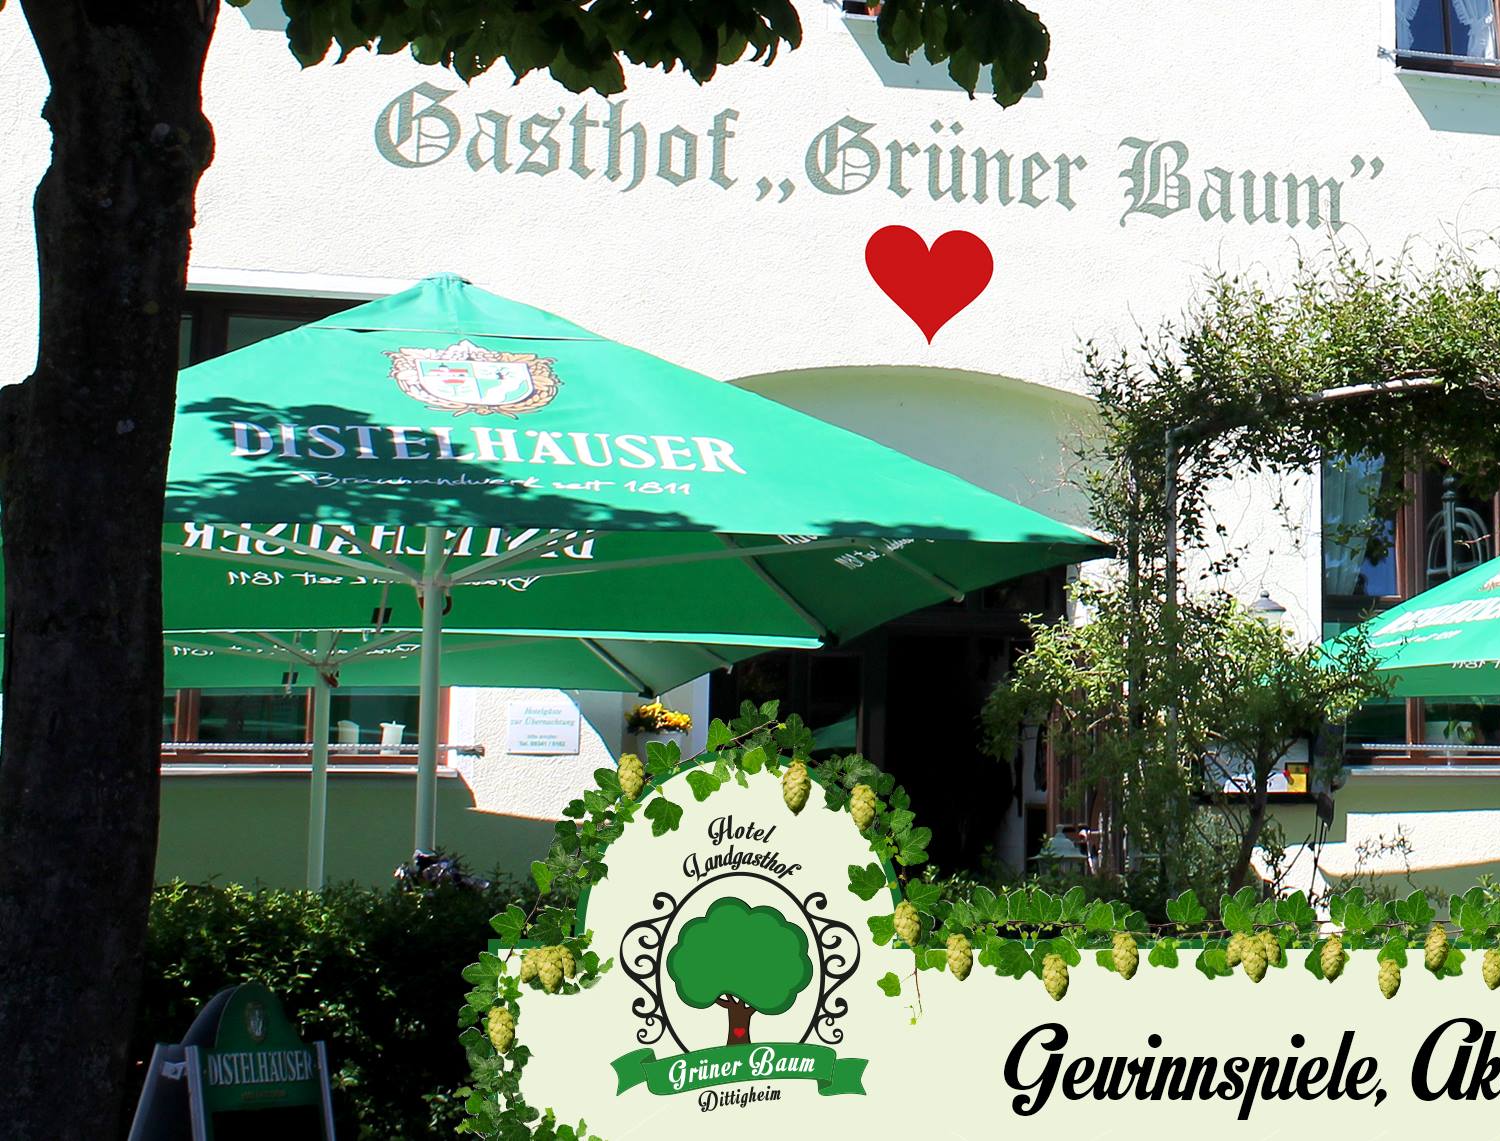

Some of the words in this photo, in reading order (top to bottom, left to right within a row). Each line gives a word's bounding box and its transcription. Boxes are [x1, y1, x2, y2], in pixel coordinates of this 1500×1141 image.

[374, 81, 740, 192] Gasthof
[229, 420, 748, 475] DISTELHÄUSER
[552, 479, 616, 492] seit
[624, 479, 691, 496] 1811
[207, 1050, 315, 1086] DISTELHÄUSER
